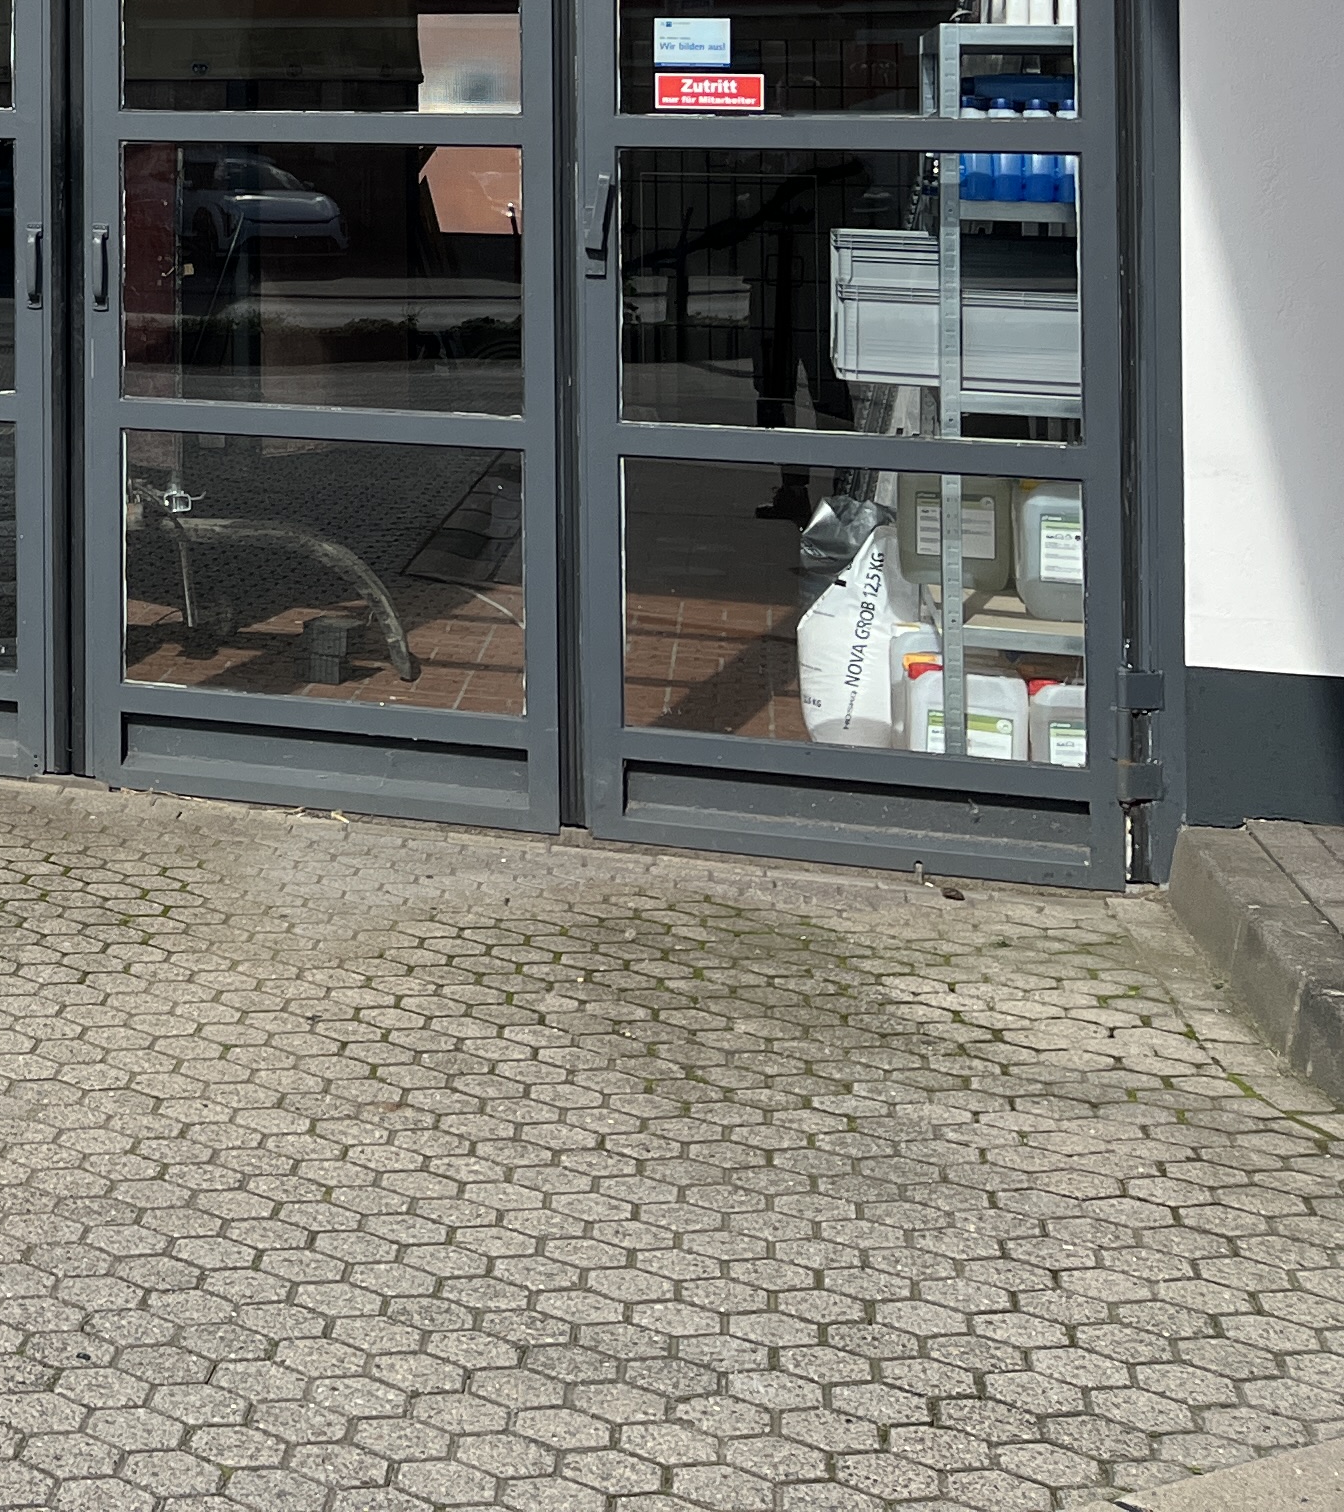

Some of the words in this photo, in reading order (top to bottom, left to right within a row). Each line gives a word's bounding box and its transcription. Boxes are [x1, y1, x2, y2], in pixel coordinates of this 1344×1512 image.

[659, 42, 676, 51] Wir
[679, 42, 705, 51] bilden
[708, 43, 726, 51] aus!
[680, 78, 738, 94] Zutritt
[661, 96, 680, 104] nur
[681, 95, 697, 104] für
[698, 95, 757, 105] Mitarbeiter
[871, 552, 886, 573] KG
[855, 601, 876, 641] GROB
[844, 644, 868, 688] NOVA
